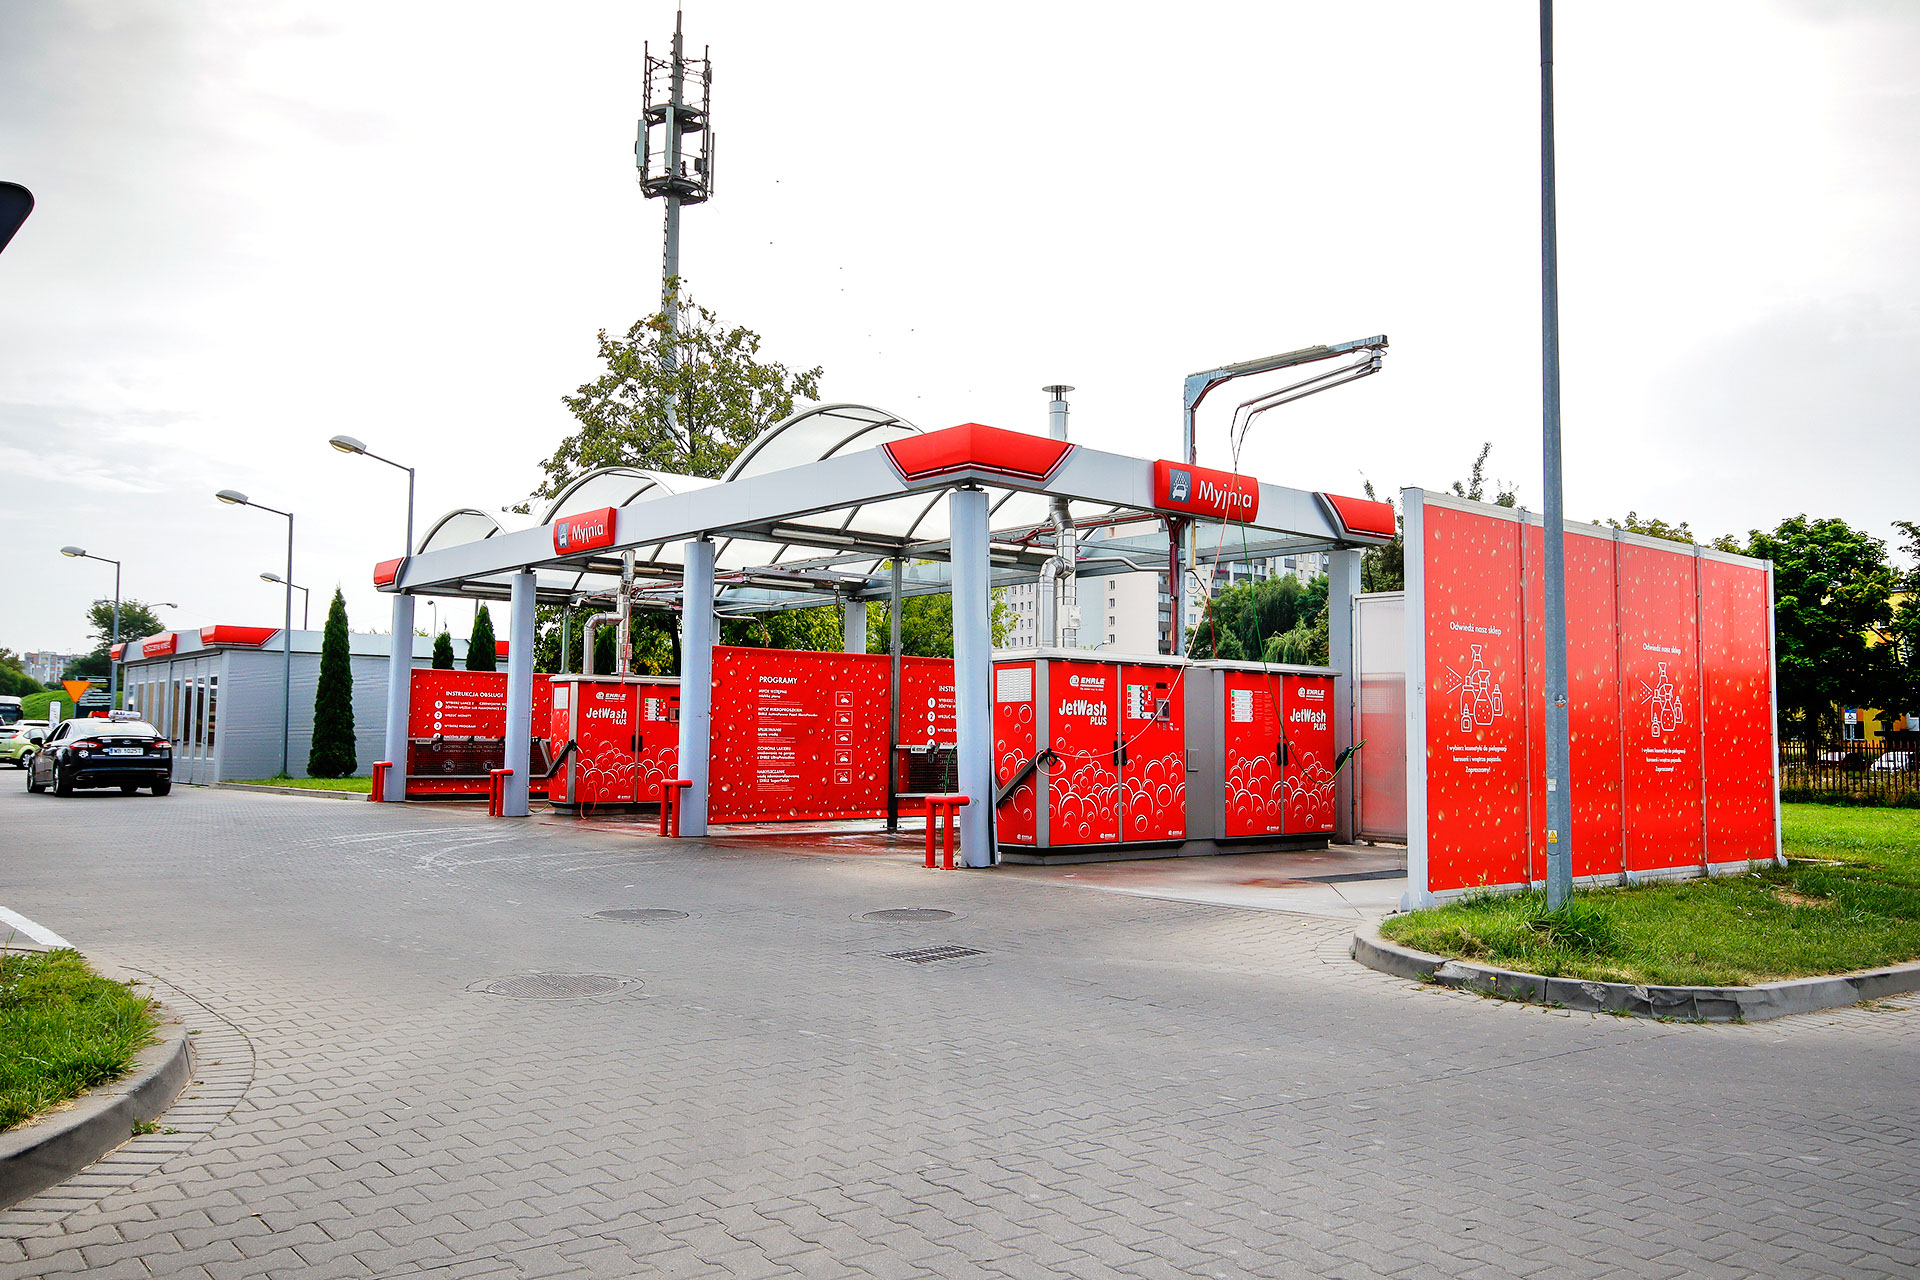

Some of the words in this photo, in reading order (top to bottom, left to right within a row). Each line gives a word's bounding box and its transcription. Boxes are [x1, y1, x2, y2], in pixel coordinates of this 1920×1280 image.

[1198, 480, 1252, 510] Myjnia
[572, 520, 604, 544] Myjnia
[1450, 621, 1474, 632] Odwiedź
[1488, 625, 1502, 637] sklep
[759, 676, 798, 684] PROGRAMY
[1080, 677, 1105, 685] EHRLE
[586, 708, 628, 719] JetWash
[1058, 699, 1107, 716] JetWash
[1090, 716, 1108, 725] PLUS
[1290, 708, 1326, 722] JetWash
